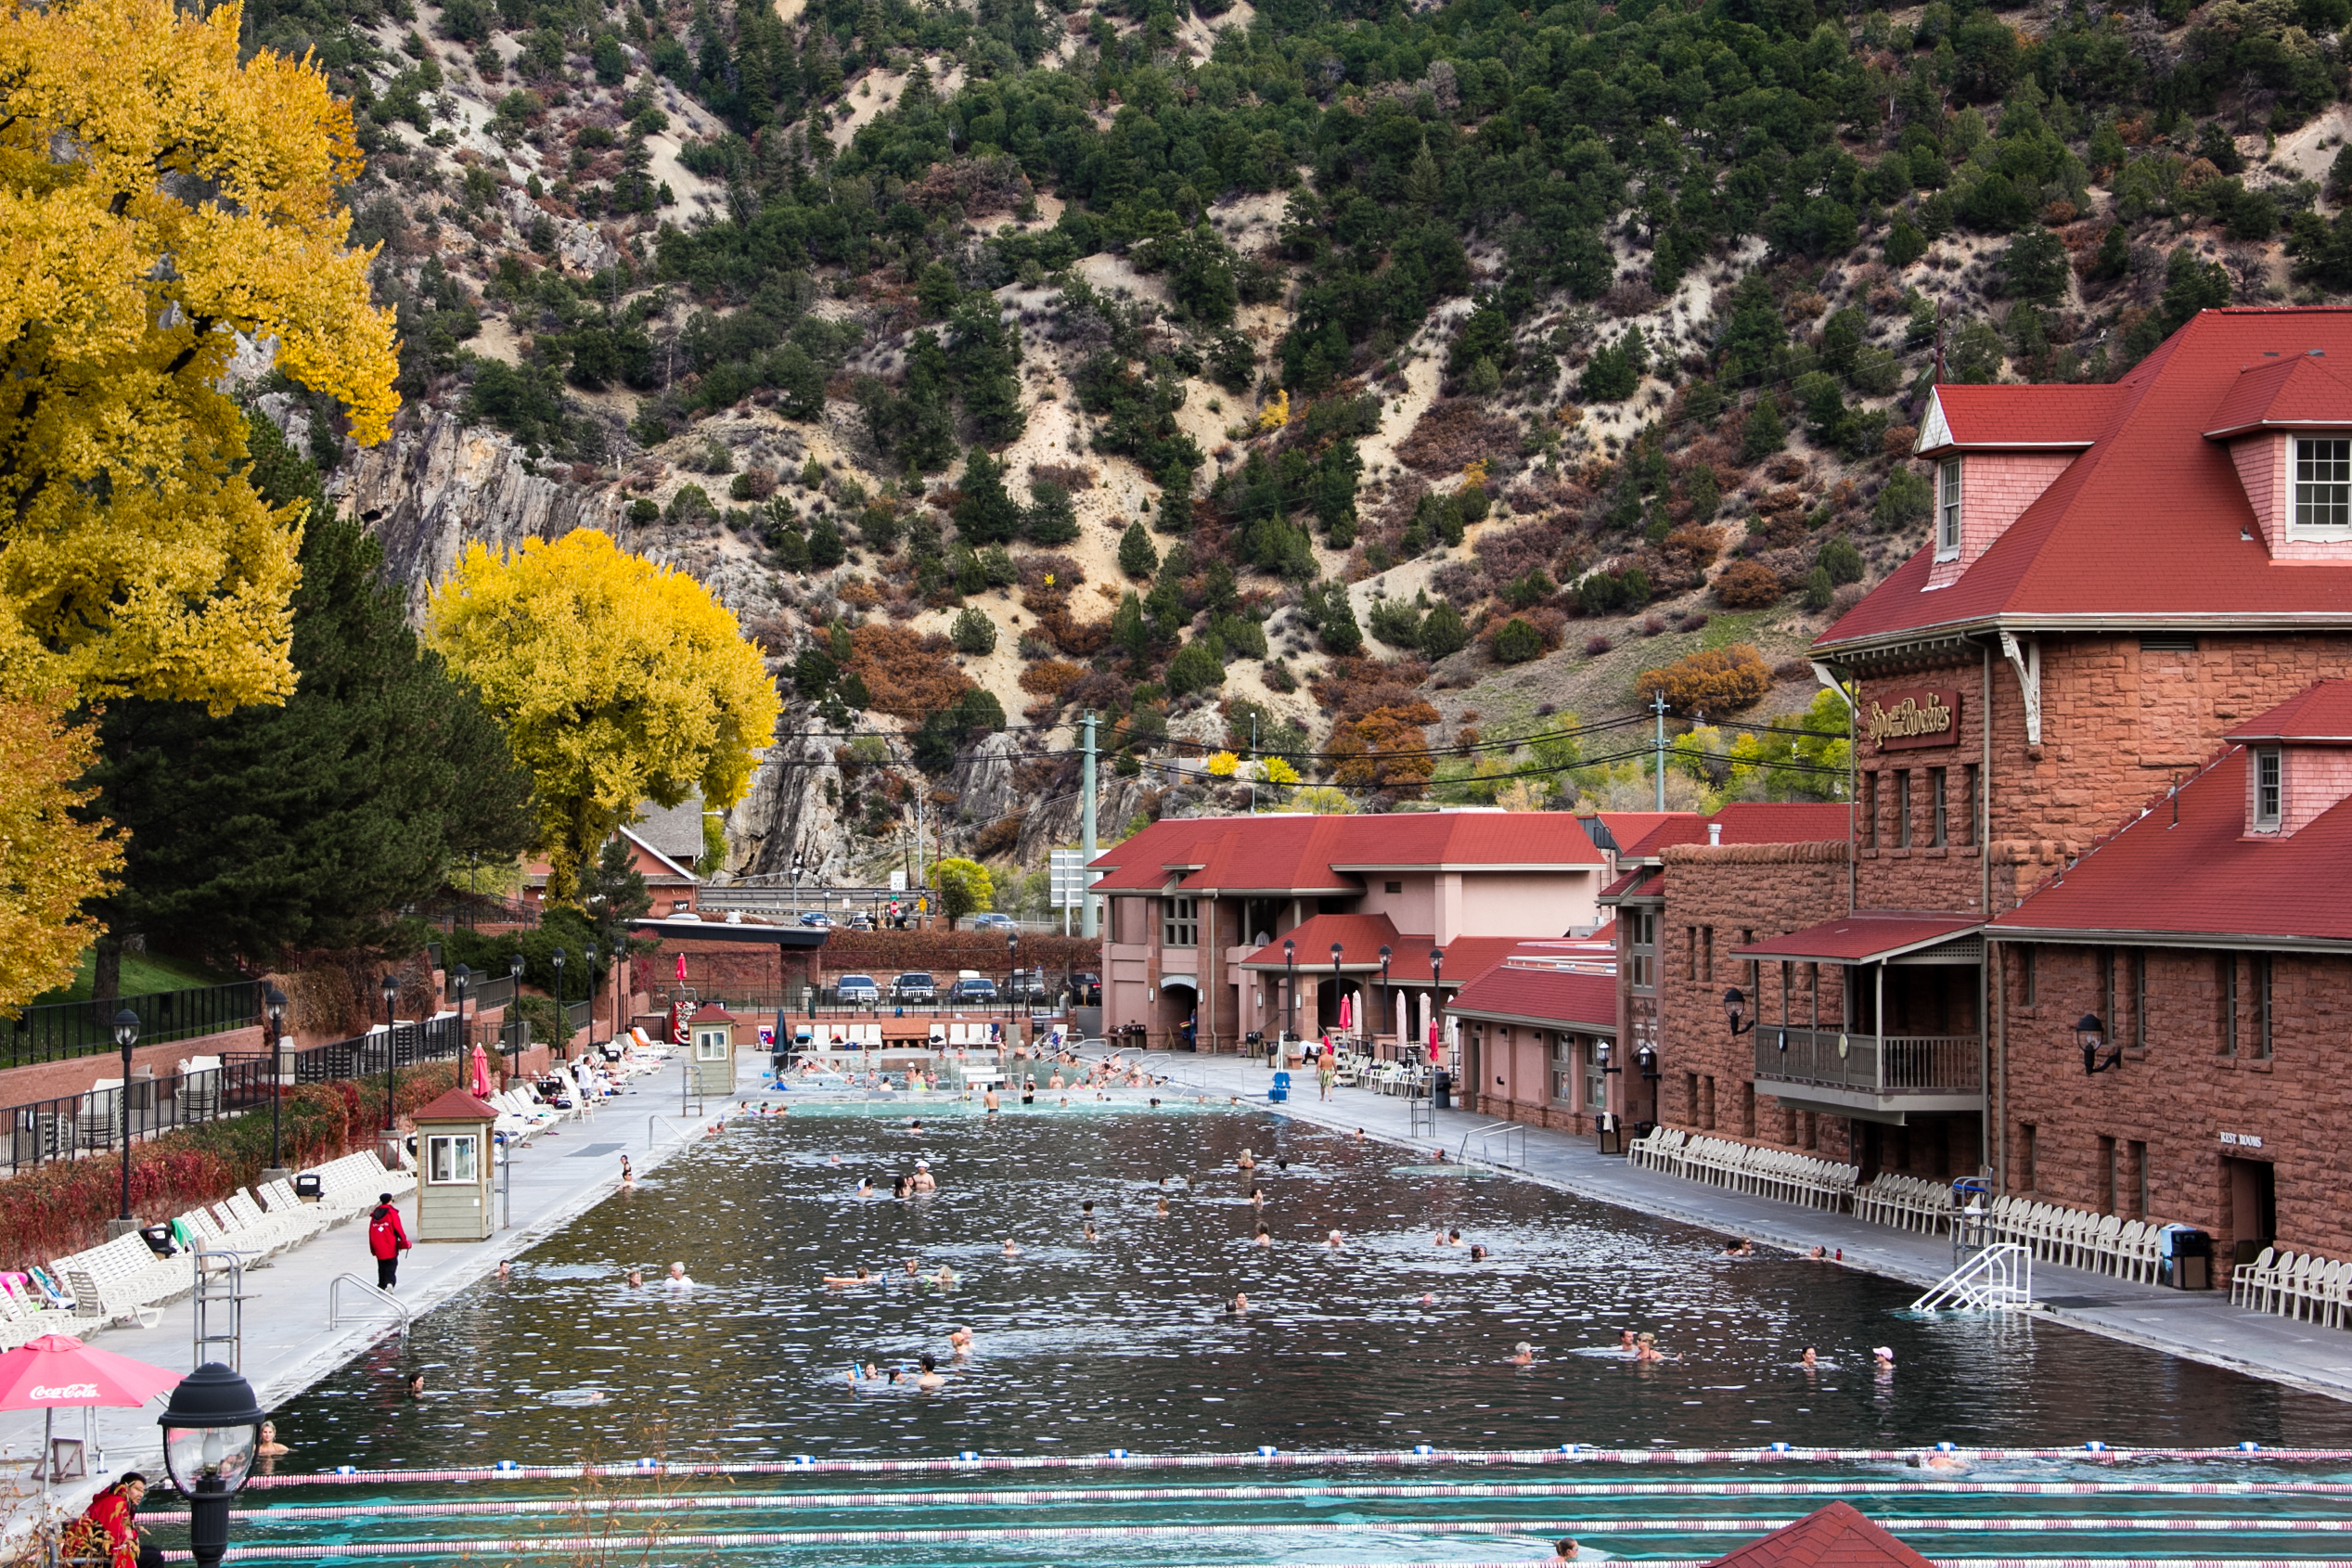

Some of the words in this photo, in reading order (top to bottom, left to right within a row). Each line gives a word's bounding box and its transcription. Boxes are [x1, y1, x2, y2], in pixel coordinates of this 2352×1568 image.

[1869, 700, 1892, 749] Spa
[1901, 692, 1951, 737] Rockies
[2220, 1132, 2237, 1144] REST
[2239, 1134, 2262, 1148] ROOMS
[30, 1383, 99, 1399] Coca-Cola
